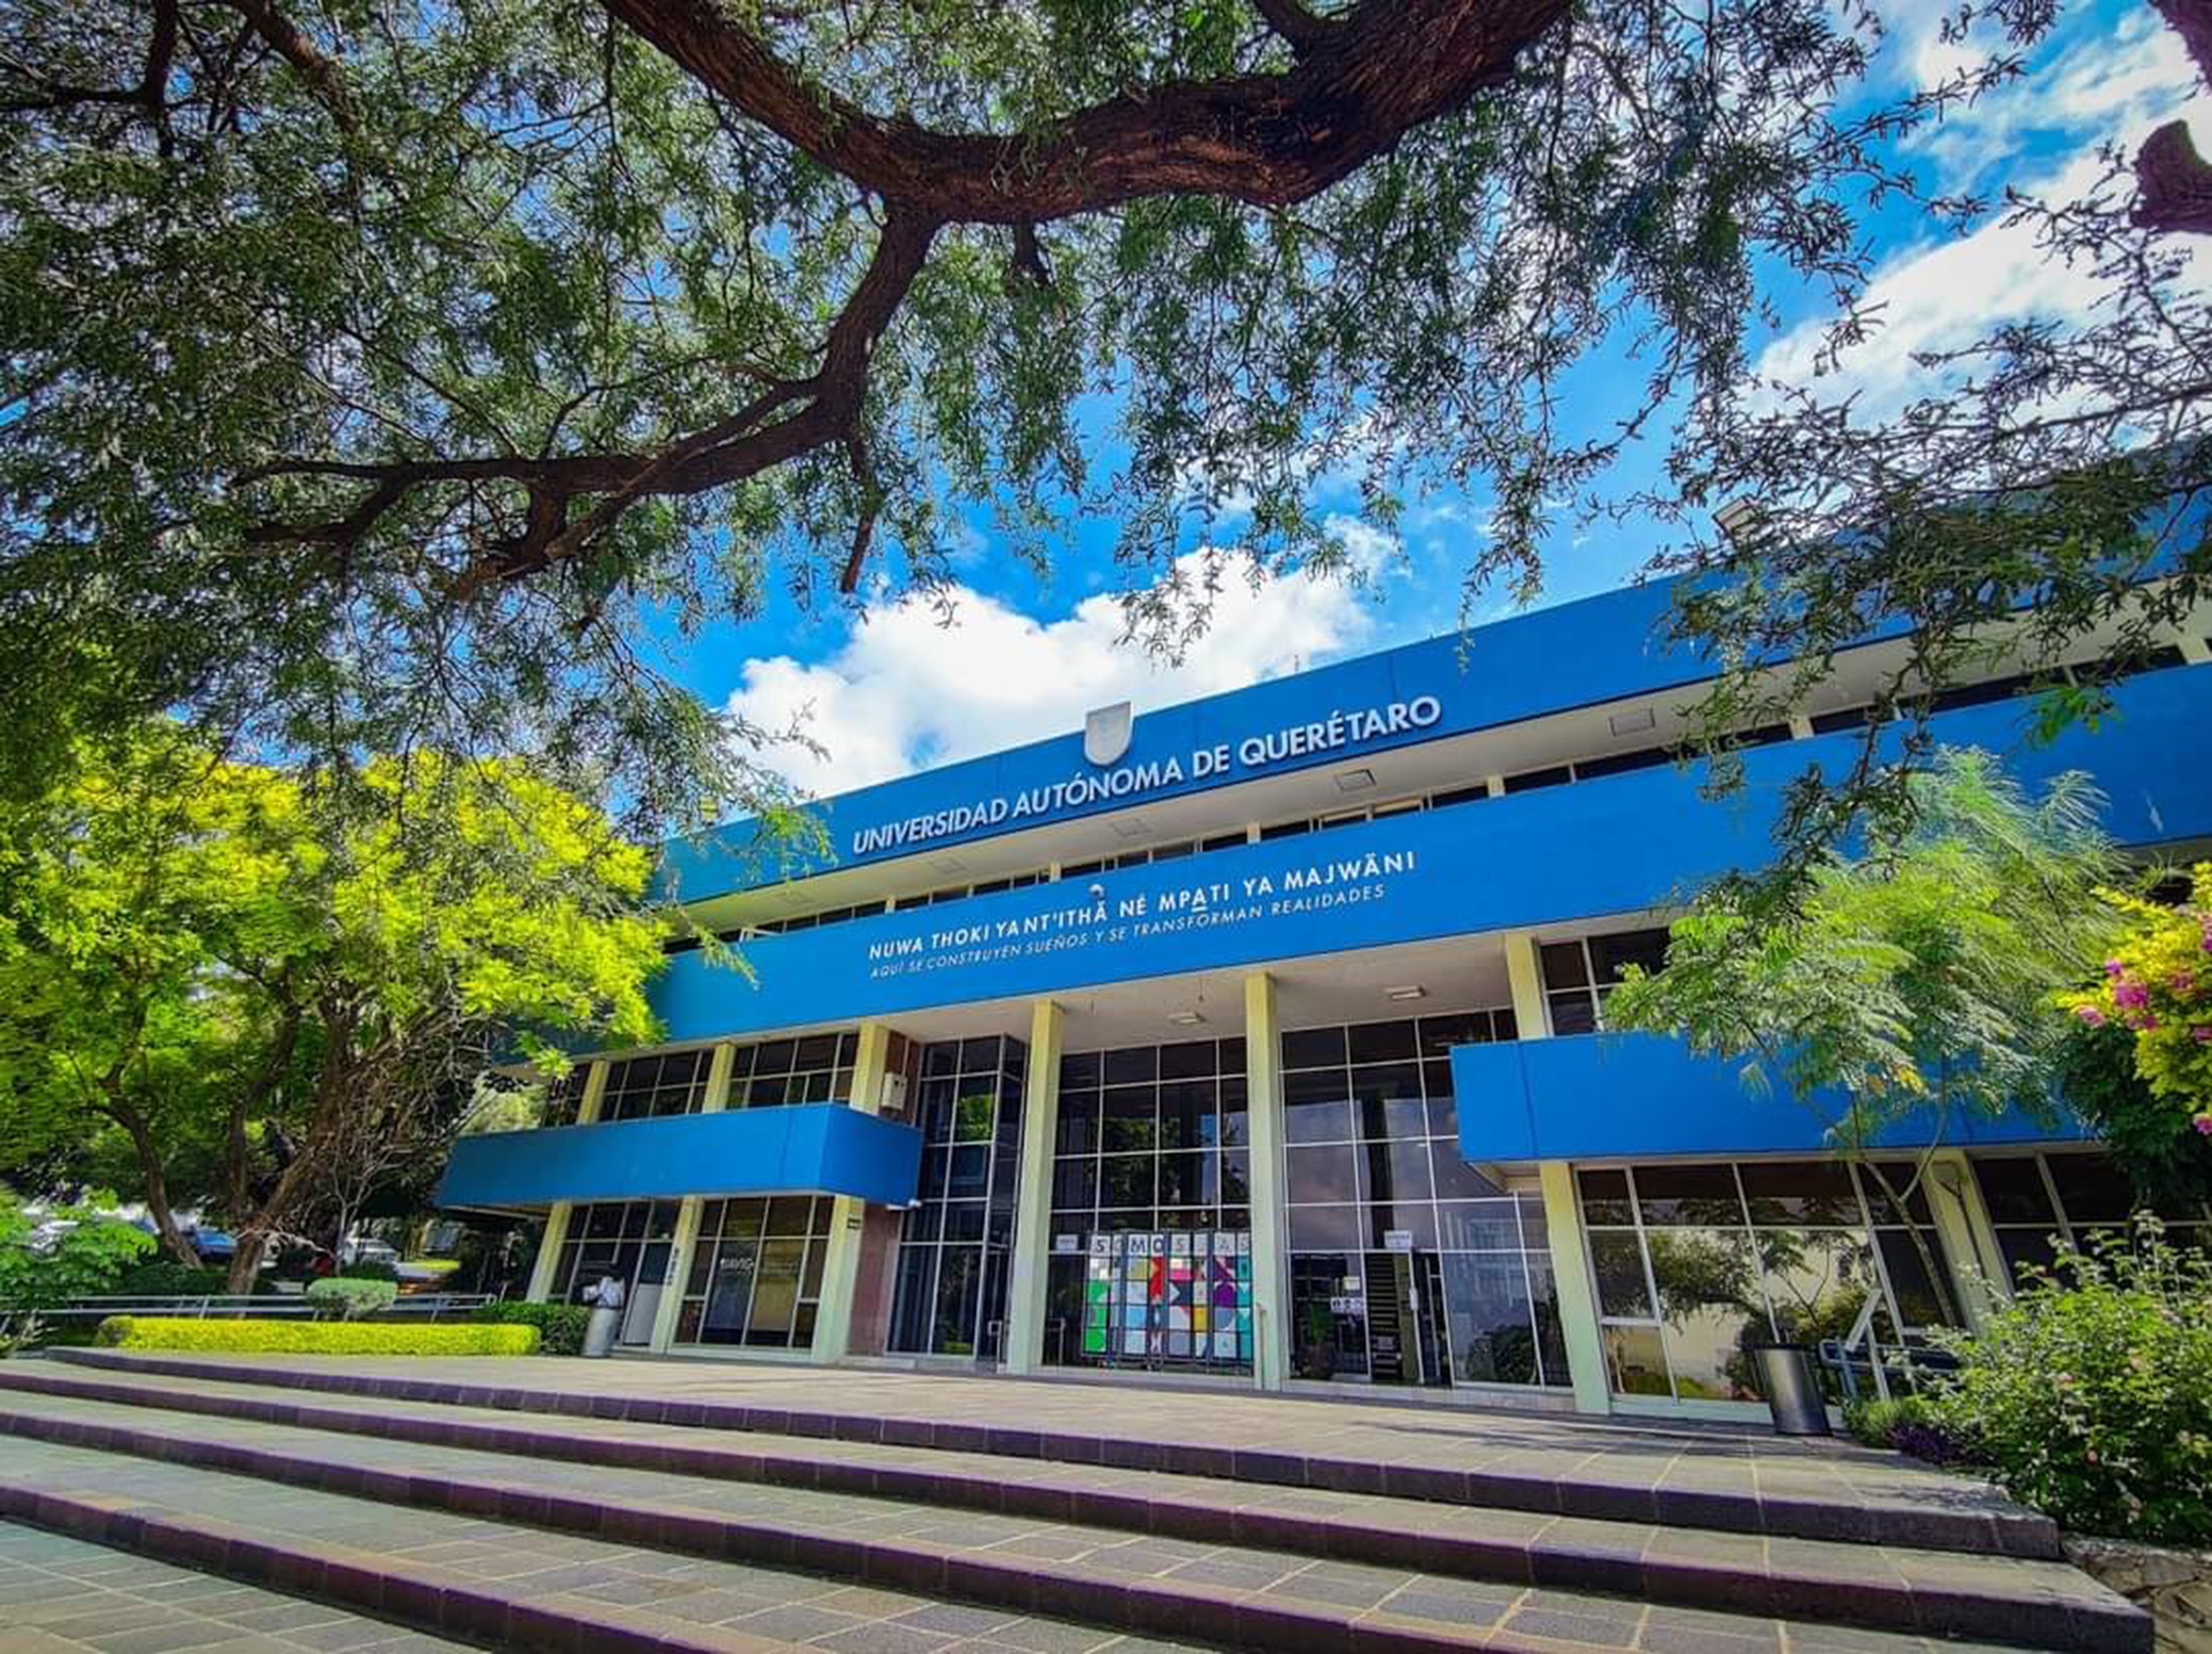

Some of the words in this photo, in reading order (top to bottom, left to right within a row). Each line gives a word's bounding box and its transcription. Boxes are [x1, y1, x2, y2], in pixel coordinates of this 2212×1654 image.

[852, 798, 1008, 854] UNIVERSIDAD
[1012, 757, 1182, 818] AUTÓNOMA
[1192, 745, 1230, 778] DE
[1240, 696, 1441, 766] QUERÉTARO
[869, 937, 923, 960] NUWA
[931, 923, 990, 950] THOKI
[1244, 874, 1273, 897] YA
[926, 943, 1022, 970] CONSTRUYEN
[1095, 930, 1105, 943] Y
[1108, 926, 1126, 942] SE
[1133, 905, 1263, 938] TRANSFORMAN
[1271, 882, 1385, 917] REALIDADES
